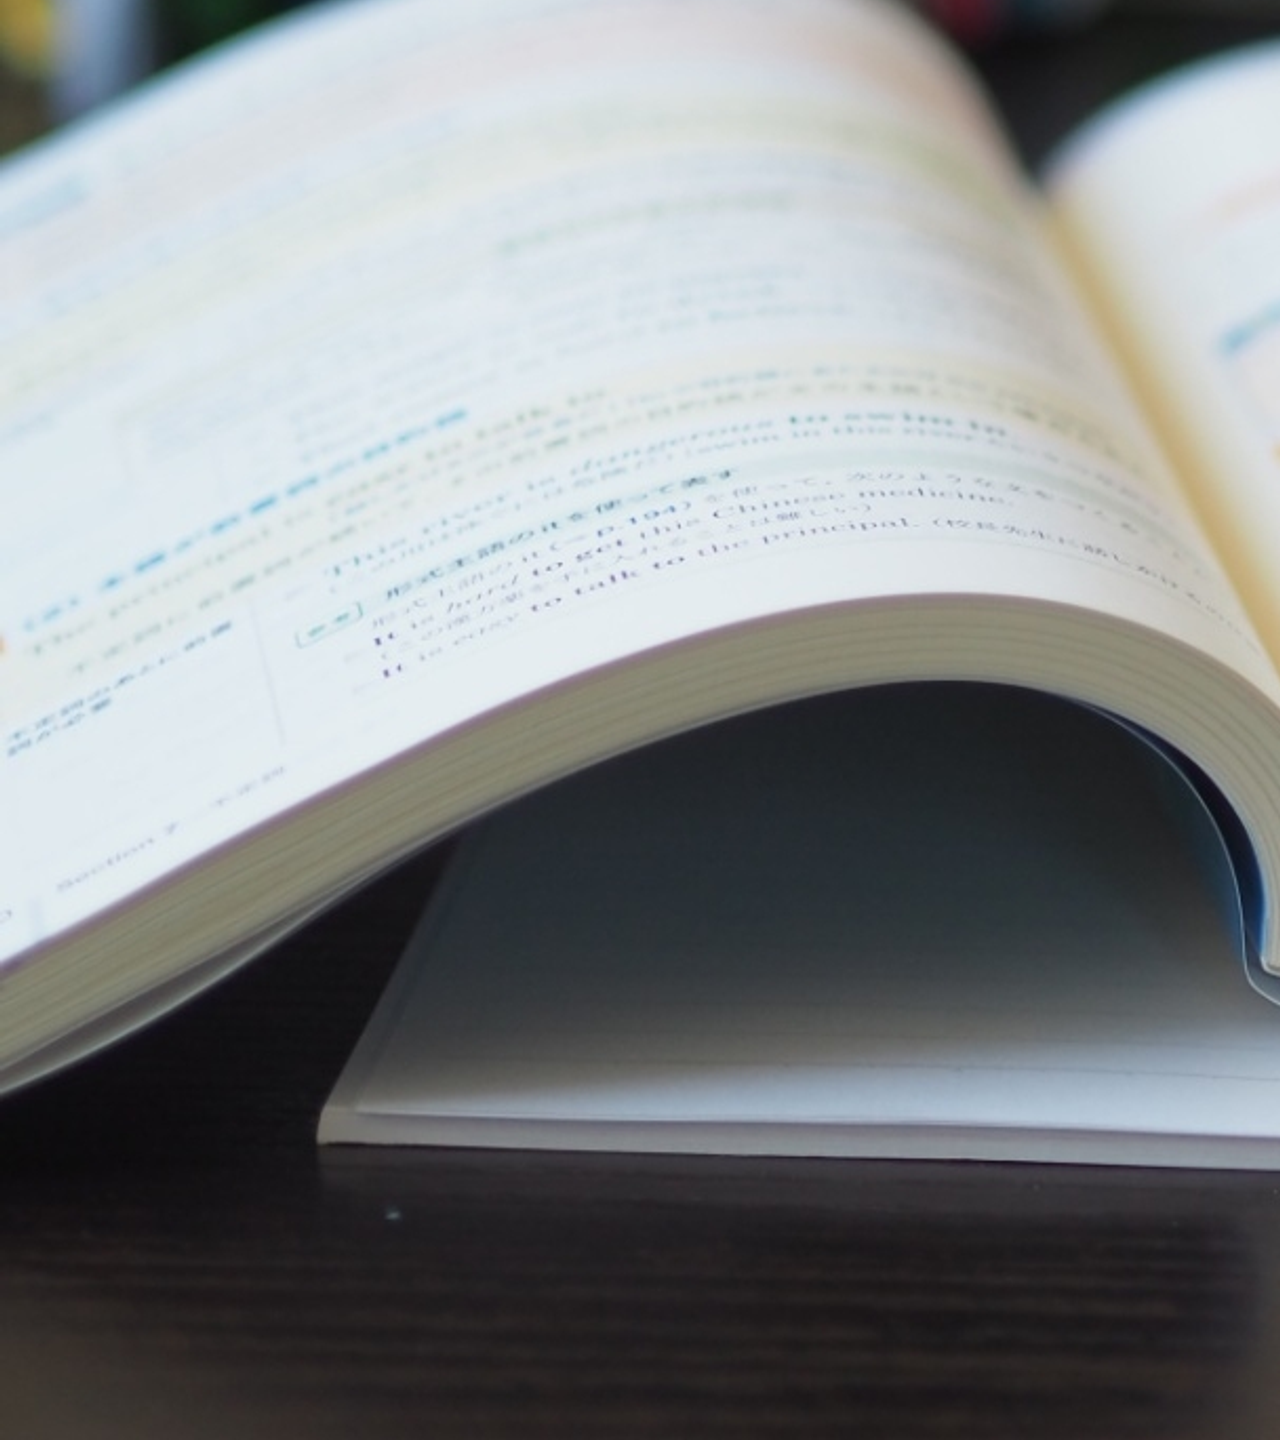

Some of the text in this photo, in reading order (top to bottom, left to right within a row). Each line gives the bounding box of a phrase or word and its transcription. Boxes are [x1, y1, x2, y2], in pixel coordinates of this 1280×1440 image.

[531, 596, 563, 613] to
[574, 569, 640, 596] talk
[652, 555, 685, 570] to
[532, 561, 564, 577] to
